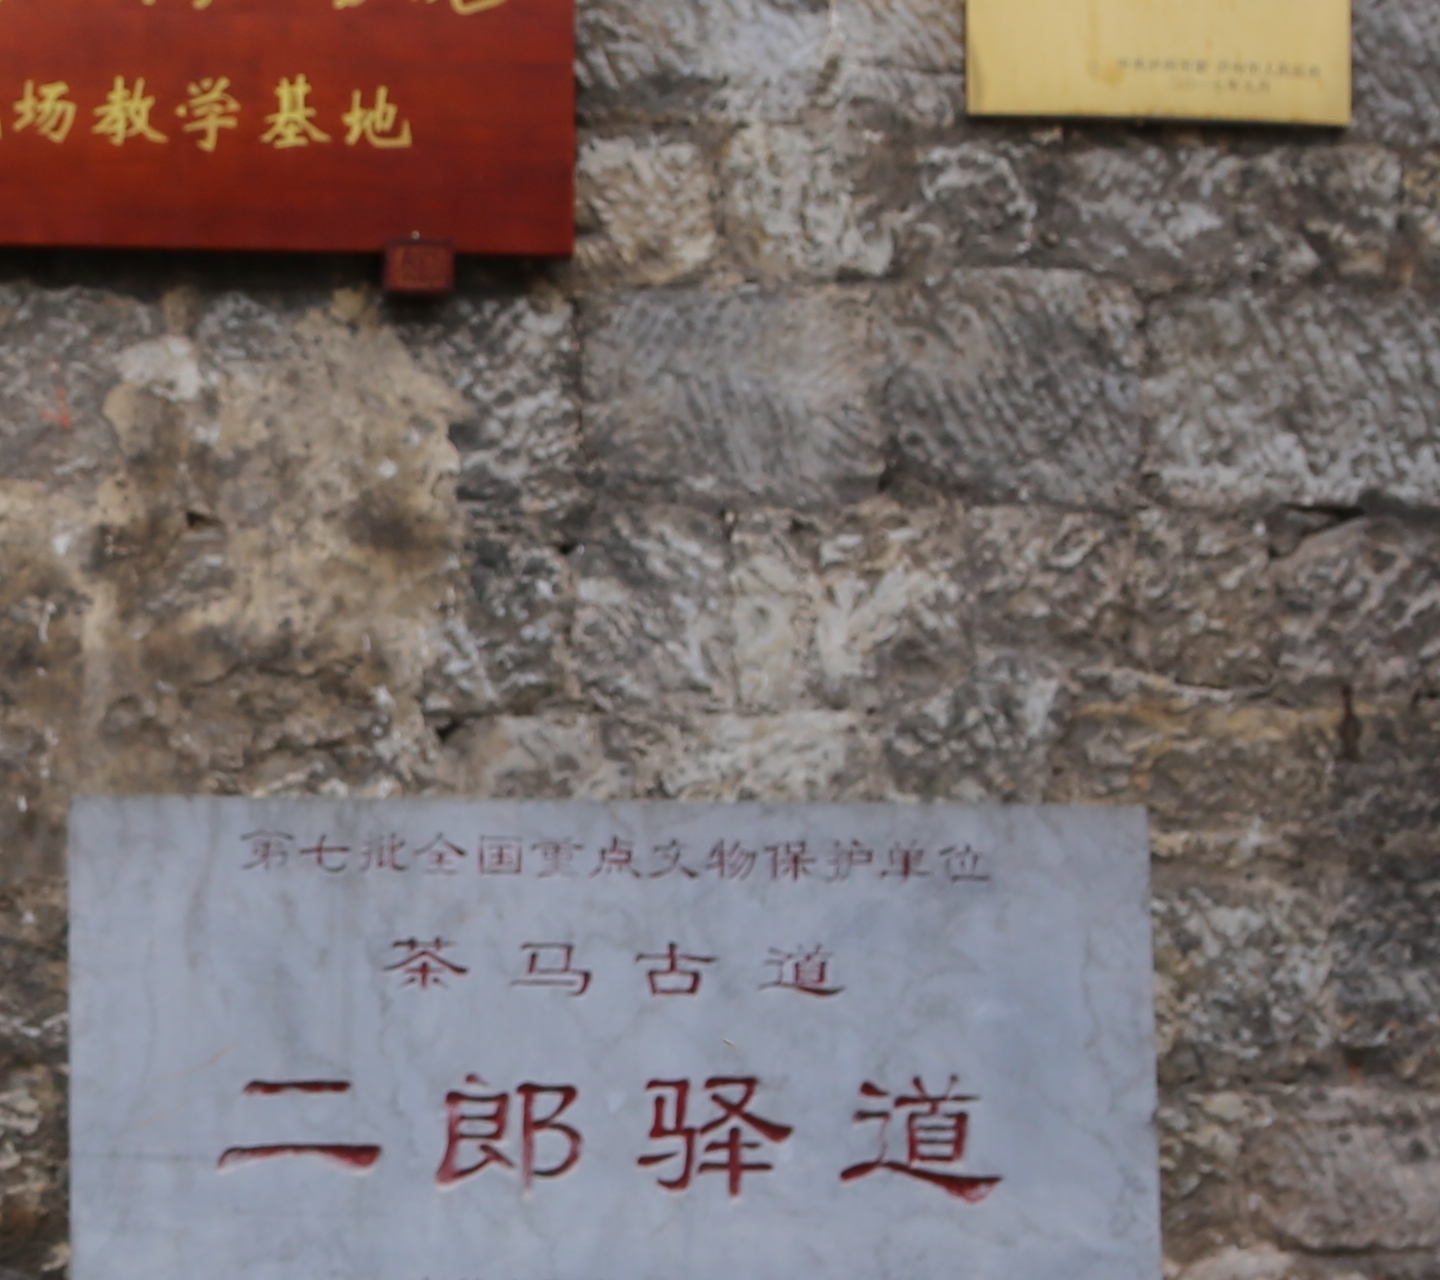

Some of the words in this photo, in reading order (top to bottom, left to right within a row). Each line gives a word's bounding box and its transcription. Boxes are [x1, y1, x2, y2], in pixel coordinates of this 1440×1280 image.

[240, 828, 992, 886] 第七批全国重点文物保护单位
[382, 936, 848, 997] 茶马古道
[216, 1073, 1002, 1204] 二郎驿道
